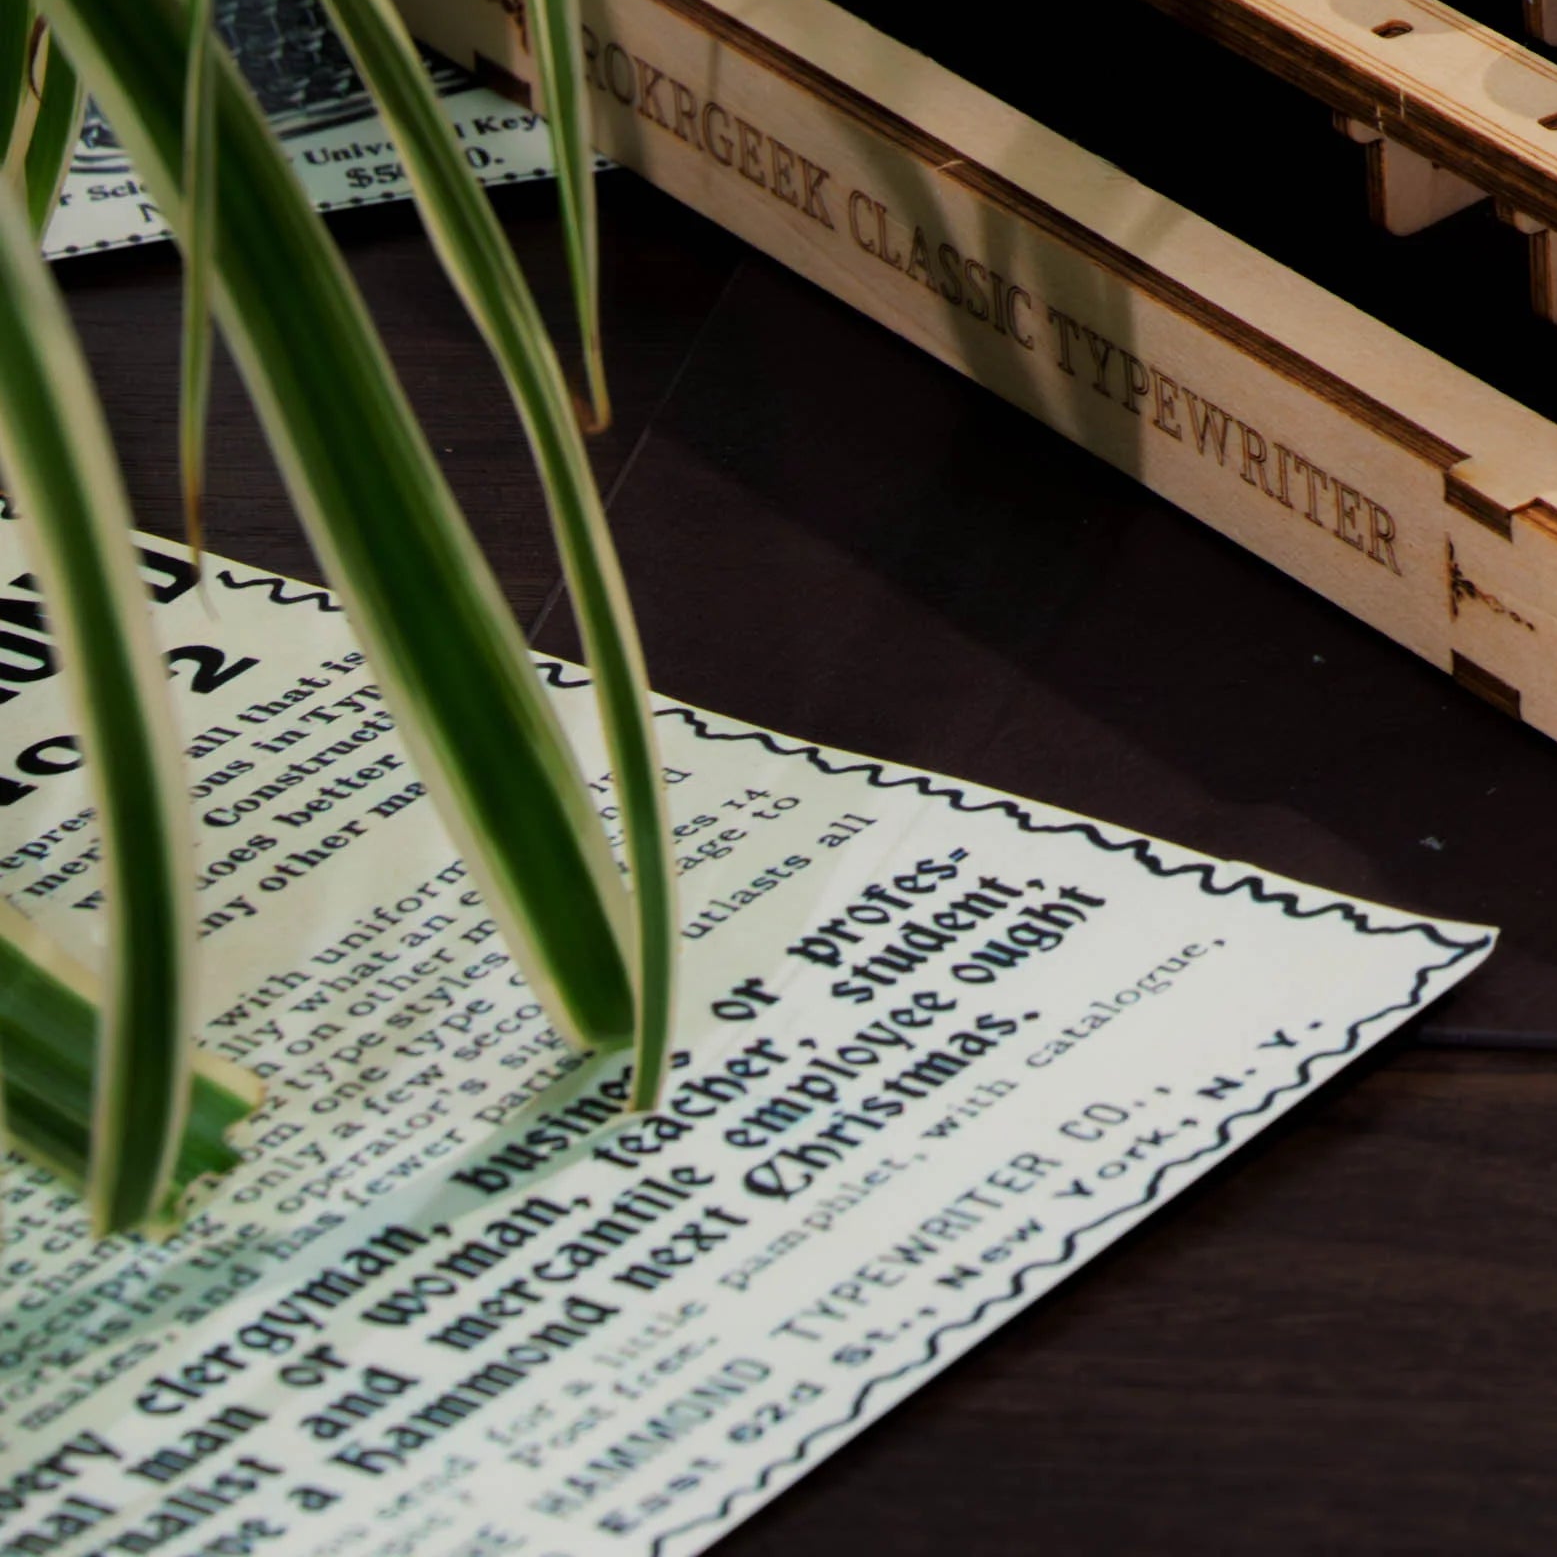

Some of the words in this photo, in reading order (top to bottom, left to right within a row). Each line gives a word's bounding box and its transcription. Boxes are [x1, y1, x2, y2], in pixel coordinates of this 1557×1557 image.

[847, 190, 1036, 351] CLASSIC
[1047, 305, 1403, 578] TYPEWRITER
[185, 727, 242, 758] all
[237, 678, 331, 723] that
[321, 653, 366, 674] is
[251, 731, 310, 753] in
[259, 821, 367, 891] other
[272, 755, 403, 827] better
[208, 972, 310, 1027] with
[274, 1079, 489, 1215] operator's
[818, 814, 876, 848] all
[283, 1033, 387, 1091] type
[385, 953, 510, 1030] styles
[286, 1023, 344, 1055] on
[346, 948, 454, 1017] other
[290, 951, 399, 1012] what
[400, 915, 457, 948] an
[311, 1067, 388, 1114] one
[393, 1000, 494, 1057] type
[752, 797, 800, 819] to
[921, 1081, 1018, 1138] with
[1025, 939, 1225, 1068] catalogue,
[127, 1407, 268, 1484] man
[278, 1344, 347, 1387] or
[360, 1198, 590, 1326] woman,
[592, 1039, 816, 1169] teacher,
[832, 877, 1045, 1003] student,
[135, 1222, 452, 1415] clergyman,
[711, 978, 779, 1021] or
[232, 1142, 328, 1205] only
[332, 1122, 364, 1139] a
[362, 1064, 444, 1115] few
[301, 1366, 419, 1440] and
[427, 1167, 714, 1351] mercantile
[724, 992, 956, 1148] employee
[951, 887, 1105, 984] ought
[342, 1128, 464, 1210] fewer
[770, 1152, 1062, 1341] TYPEWRITER
[1058, 1086, 1171, 1142] CO.,
[936, 1219, 1042, 1289] New
[1056, 1118, 1198, 1197] York,
[1197, 1070, 1256, 1100] N.
[1259, 1022, 1322, 1048] Y.
[289, 1487, 339, 1511] a
[612, 1208, 748, 1291] next
[743, 1012, 1039, 1201] Christmas.
